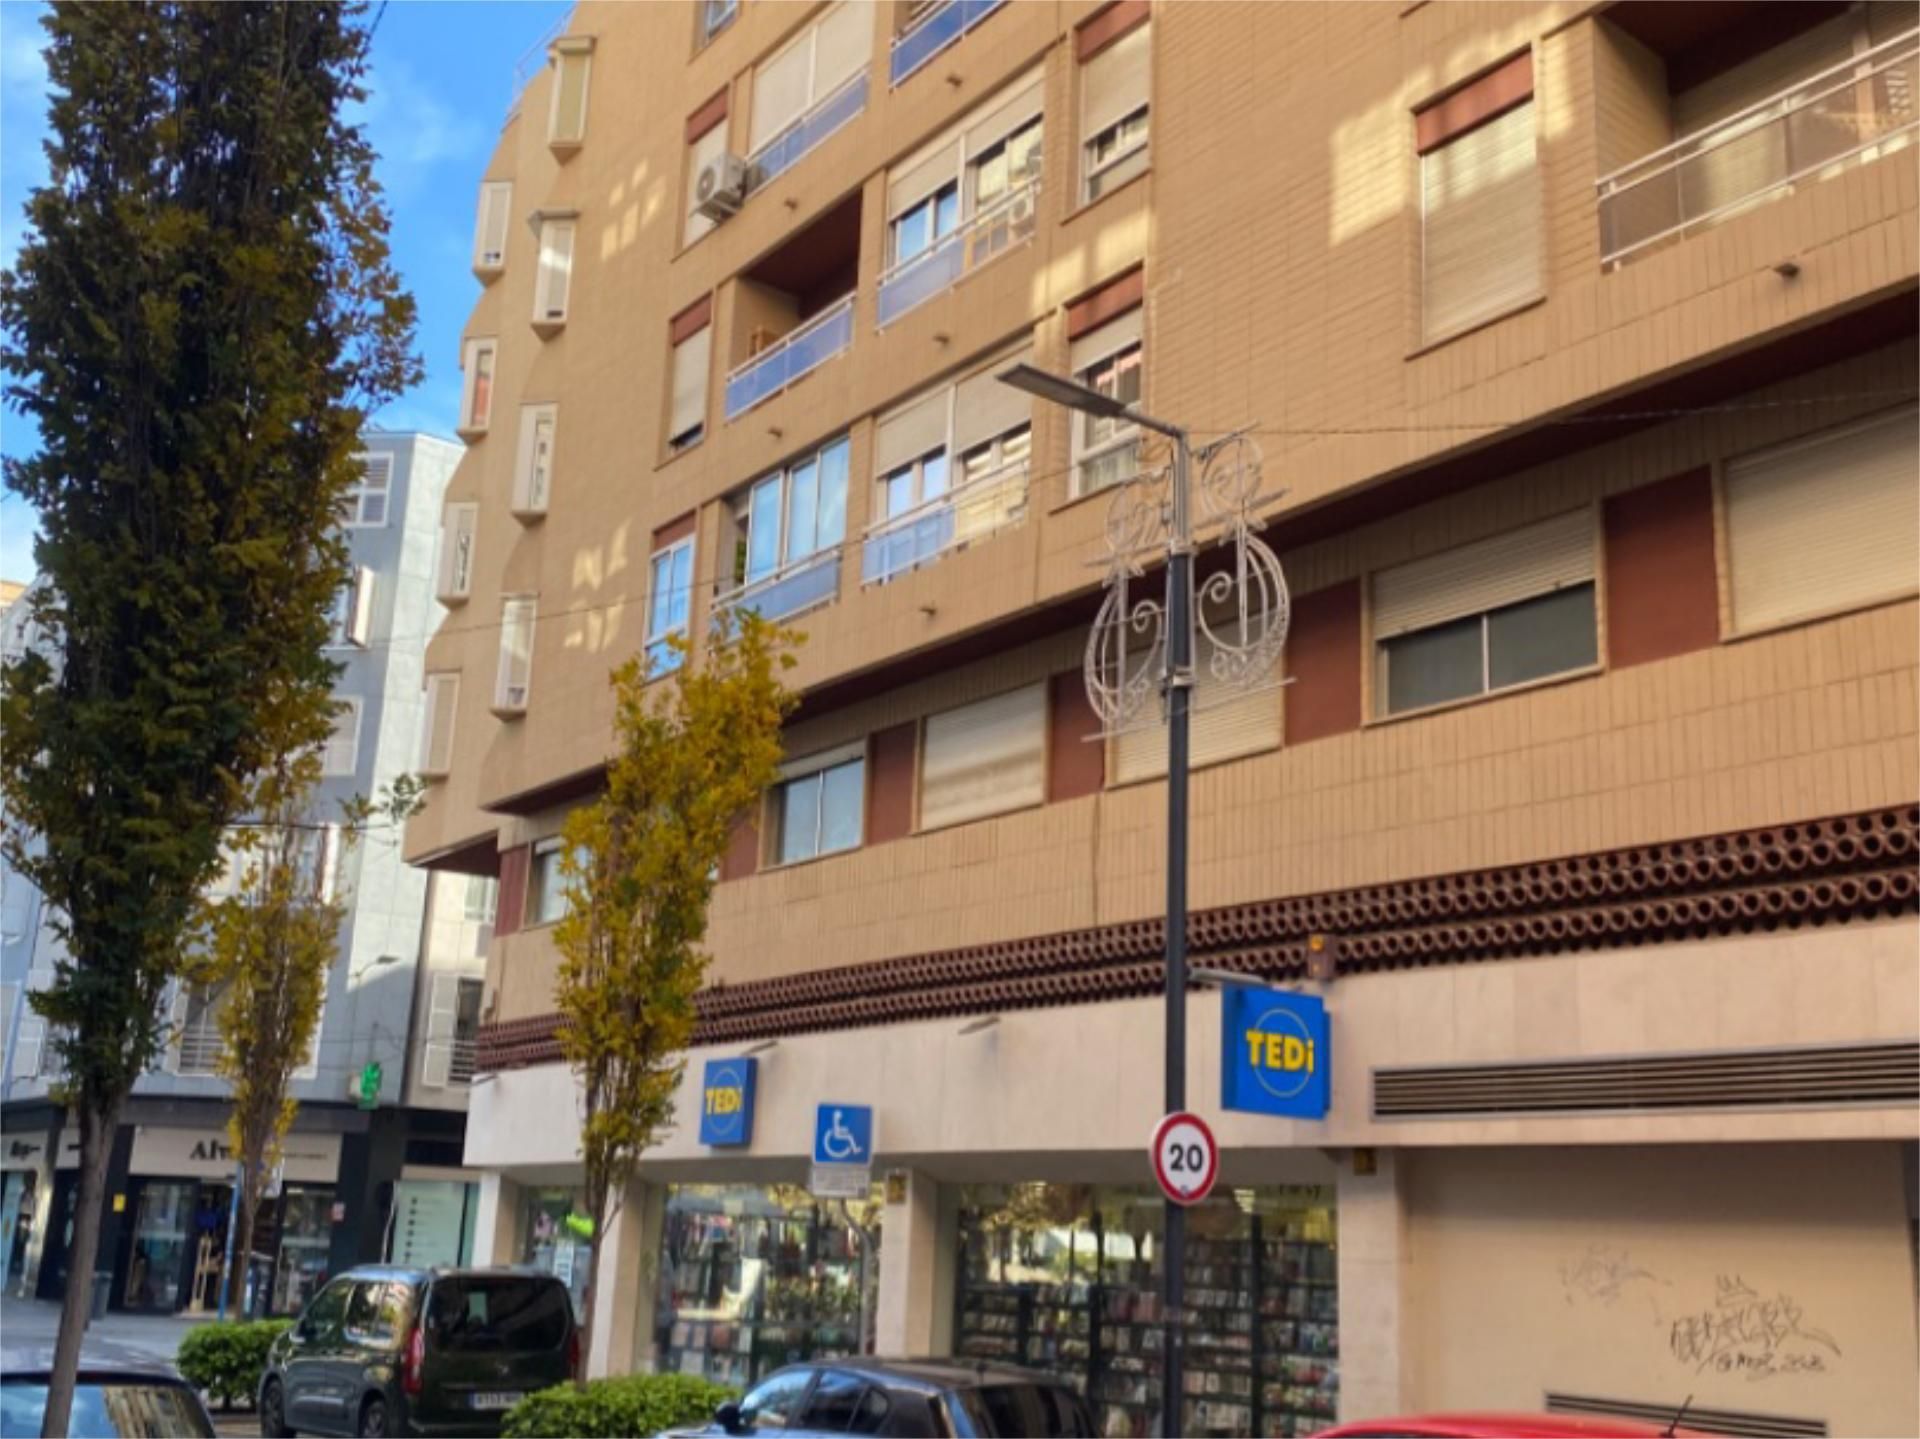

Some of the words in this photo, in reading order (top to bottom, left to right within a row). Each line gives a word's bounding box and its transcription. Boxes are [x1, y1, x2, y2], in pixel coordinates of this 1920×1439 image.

[1245, 1028, 1315, 1074] TEDi
[704, 1086, 743, 1116] TEDi
[1169, 1142, 1204, 1173] 20
